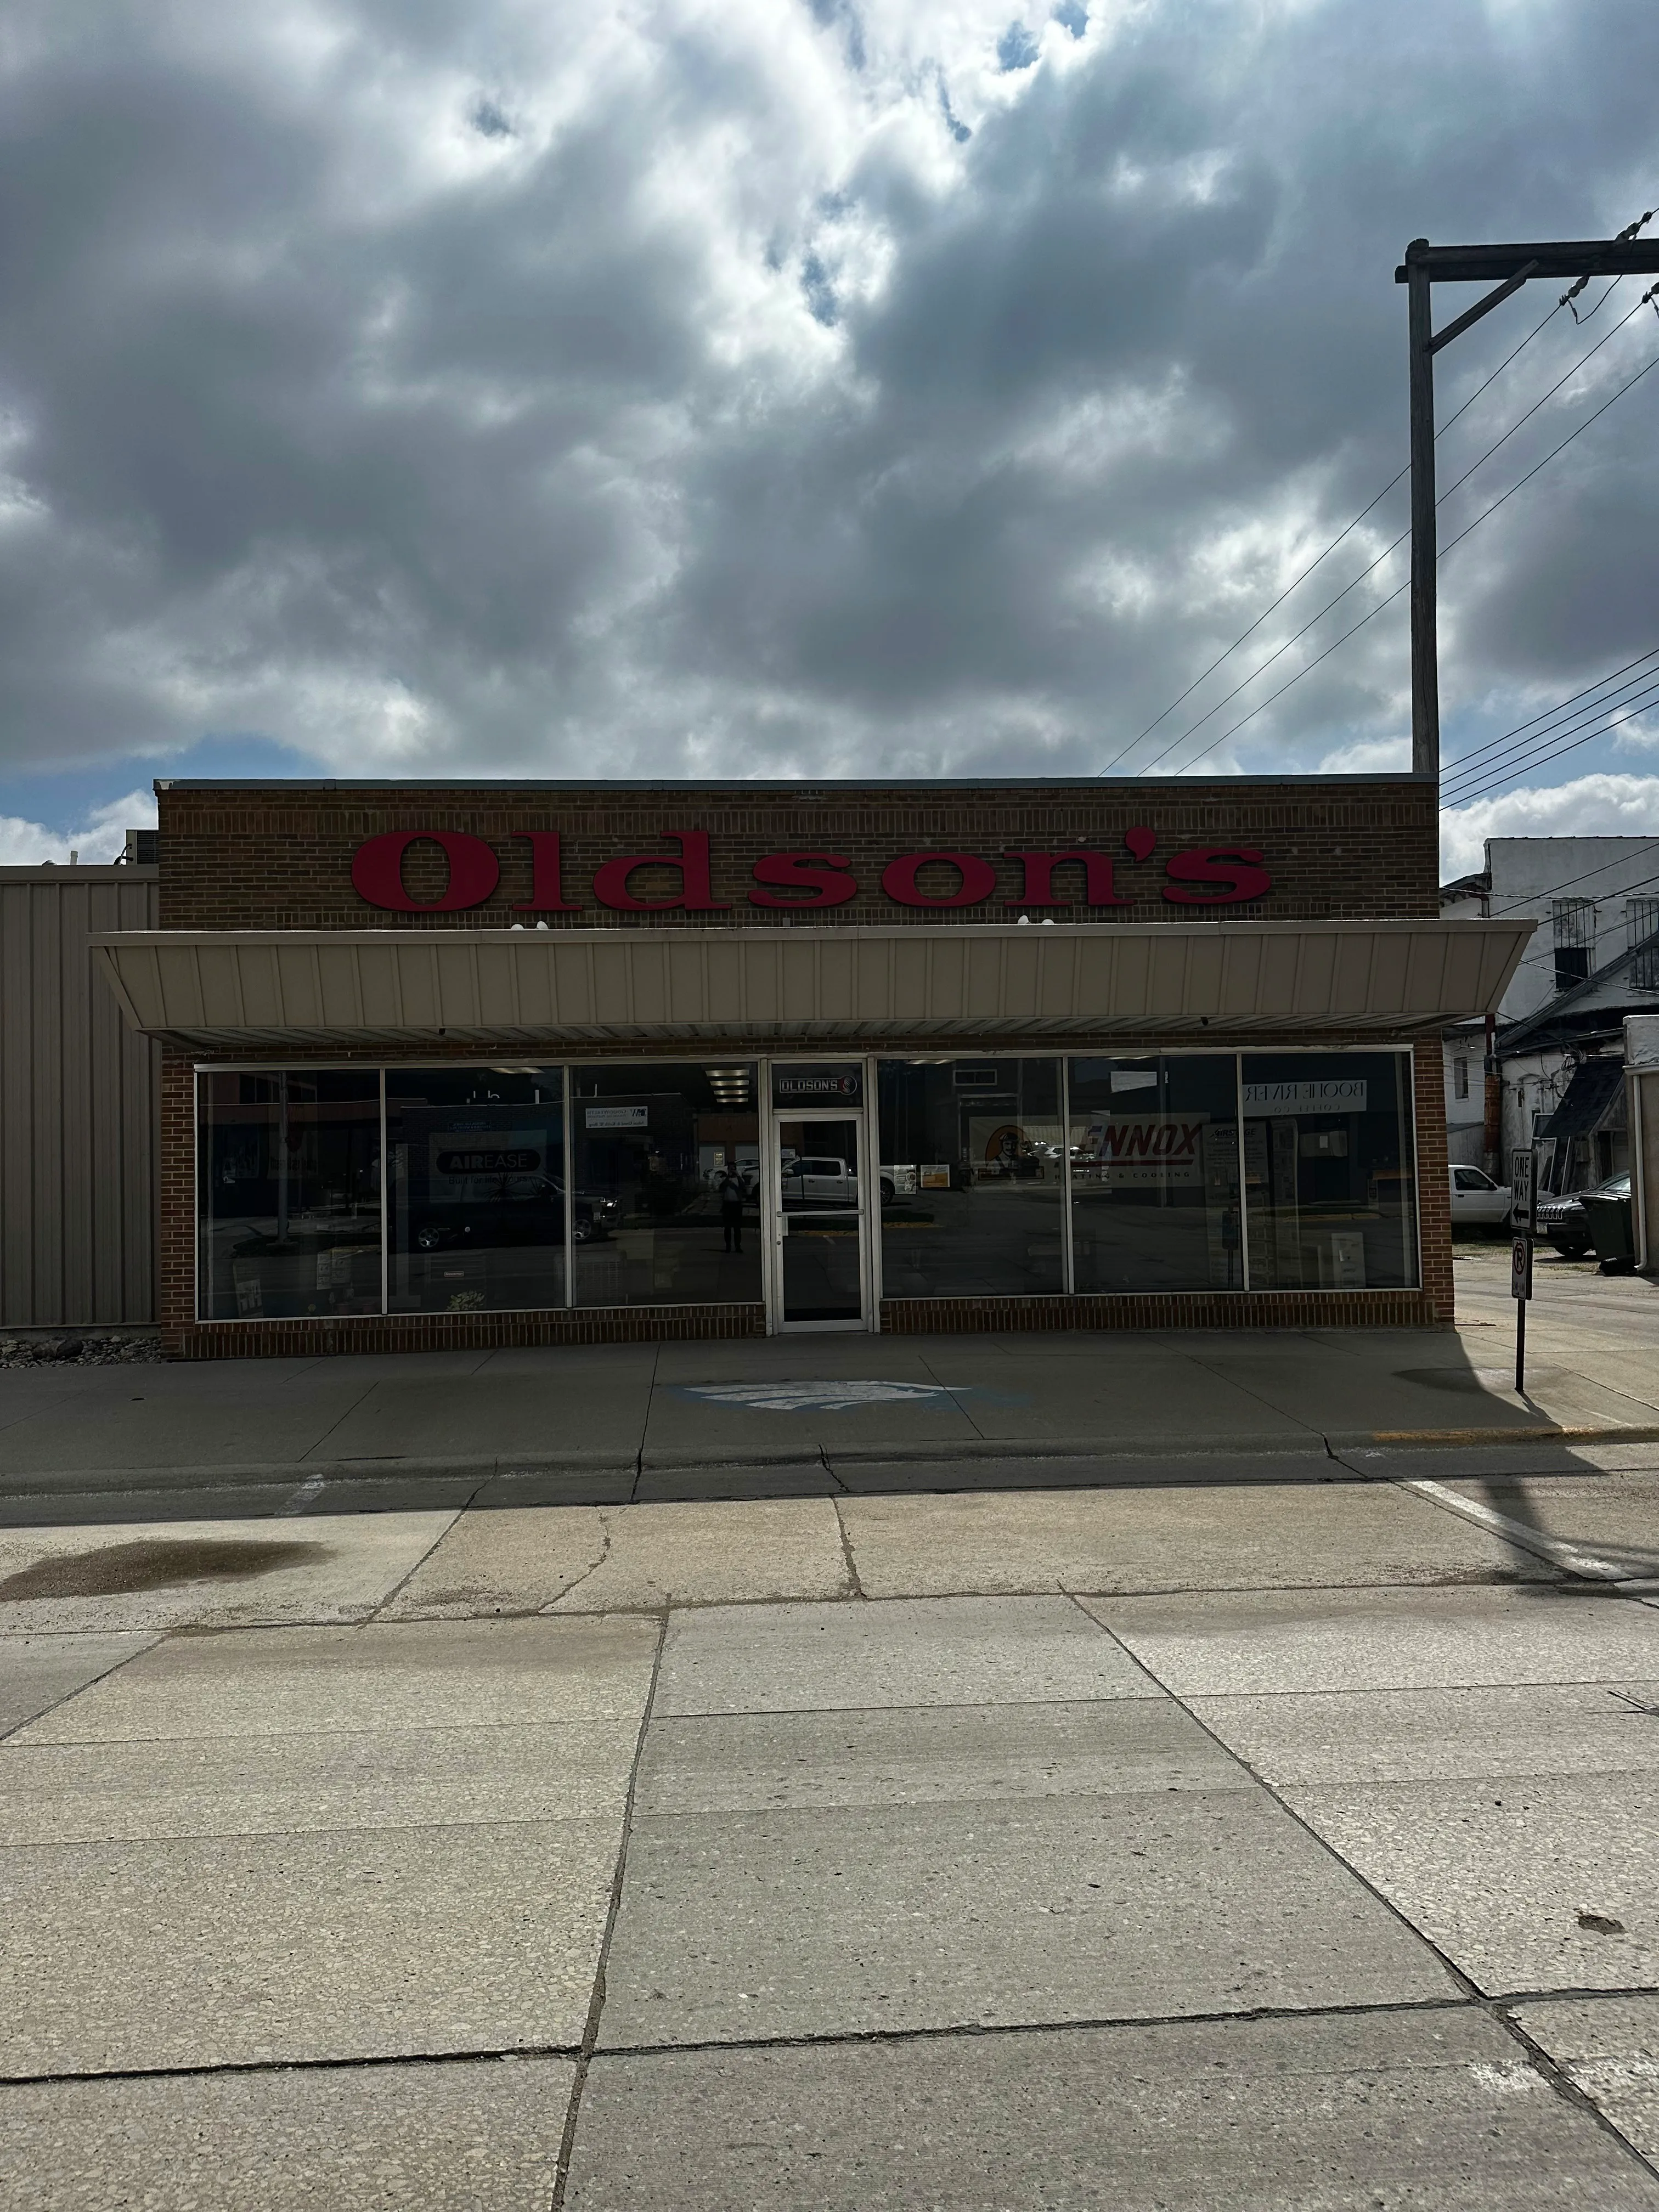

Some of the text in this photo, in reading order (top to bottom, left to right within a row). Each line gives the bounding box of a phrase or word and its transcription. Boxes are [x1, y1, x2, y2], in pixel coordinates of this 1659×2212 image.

[351, 825, 1272, 912] Oldson's
[782, 1080, 838, 1091] OLDSON'S
[1069, 1124, 1203, 1156] ENNOX
[449, 1154, 527, 1169] AIREASE
[1515, 1156, 1530, 1178] ONE
[449, 1176, 467, 1184] Built
[1514, 1180, 1529, 1201] WAY
